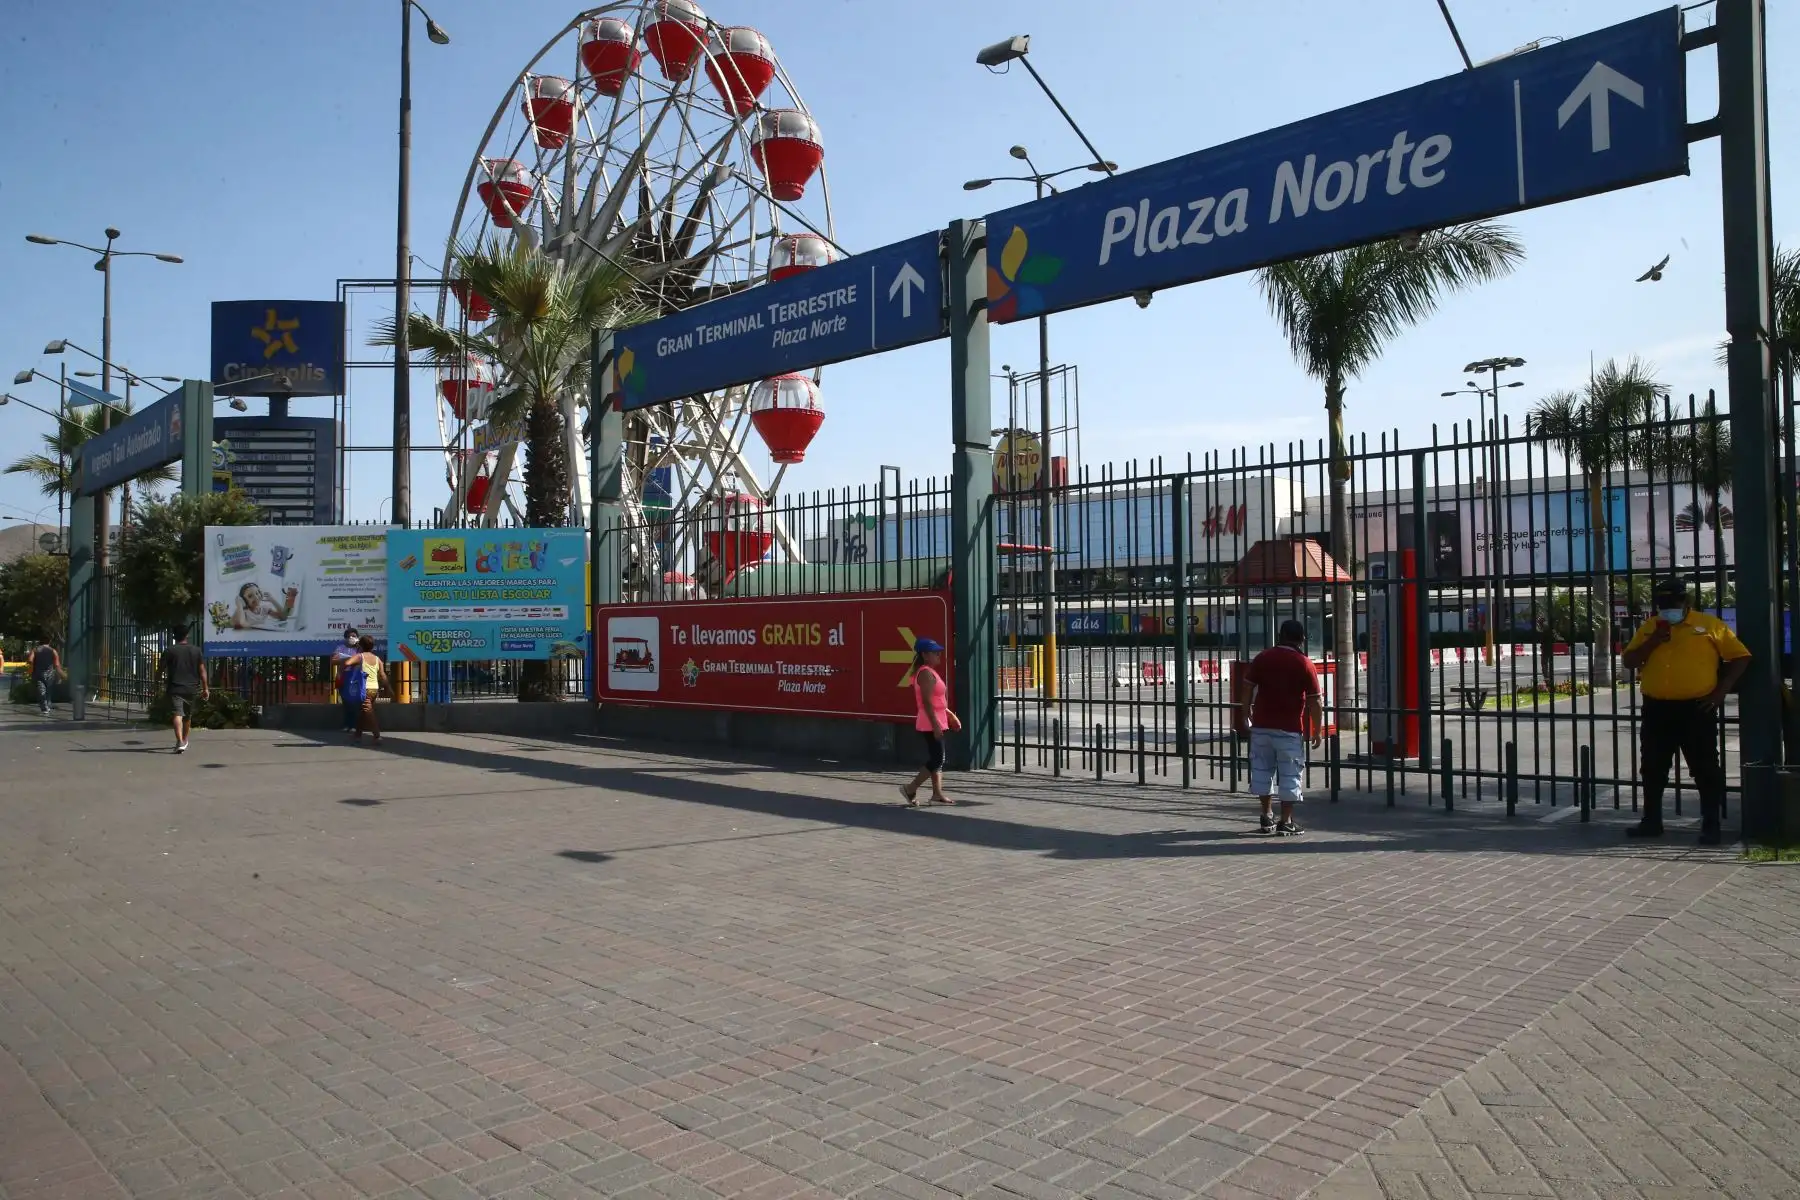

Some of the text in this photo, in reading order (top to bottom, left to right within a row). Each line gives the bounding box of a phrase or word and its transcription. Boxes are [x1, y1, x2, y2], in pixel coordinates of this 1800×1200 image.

[1099, 131, 1453, 266] Plaza Norte
[657, 284, 857, 357] GRAN TERMINAL TERRESTRE
[772, 315, 847, 349] Plaza Norte
[113, 438, 125, 466] Taxi
[127, 420, 162, 458] Autorizado
[414, 578, 557, 587] ENCUENTRA LAS MEJORES MARCAS PARA
[419, 589, 552, 601] TODA TU LISTA ESCOLAR
[415, 630, 433, 646] 10
[432, 630, 471, 640] FEBRERO
[670, 622, 845, 646] Te llevamos GRATIS al
[432, 639, 451, 653] 23
[451, 639, 486, 649] MARZO
[702, 659, 832, 677] GRAN TERMINAL TERRESTRE
[777, 679, 827, 695] Plaza Norte
